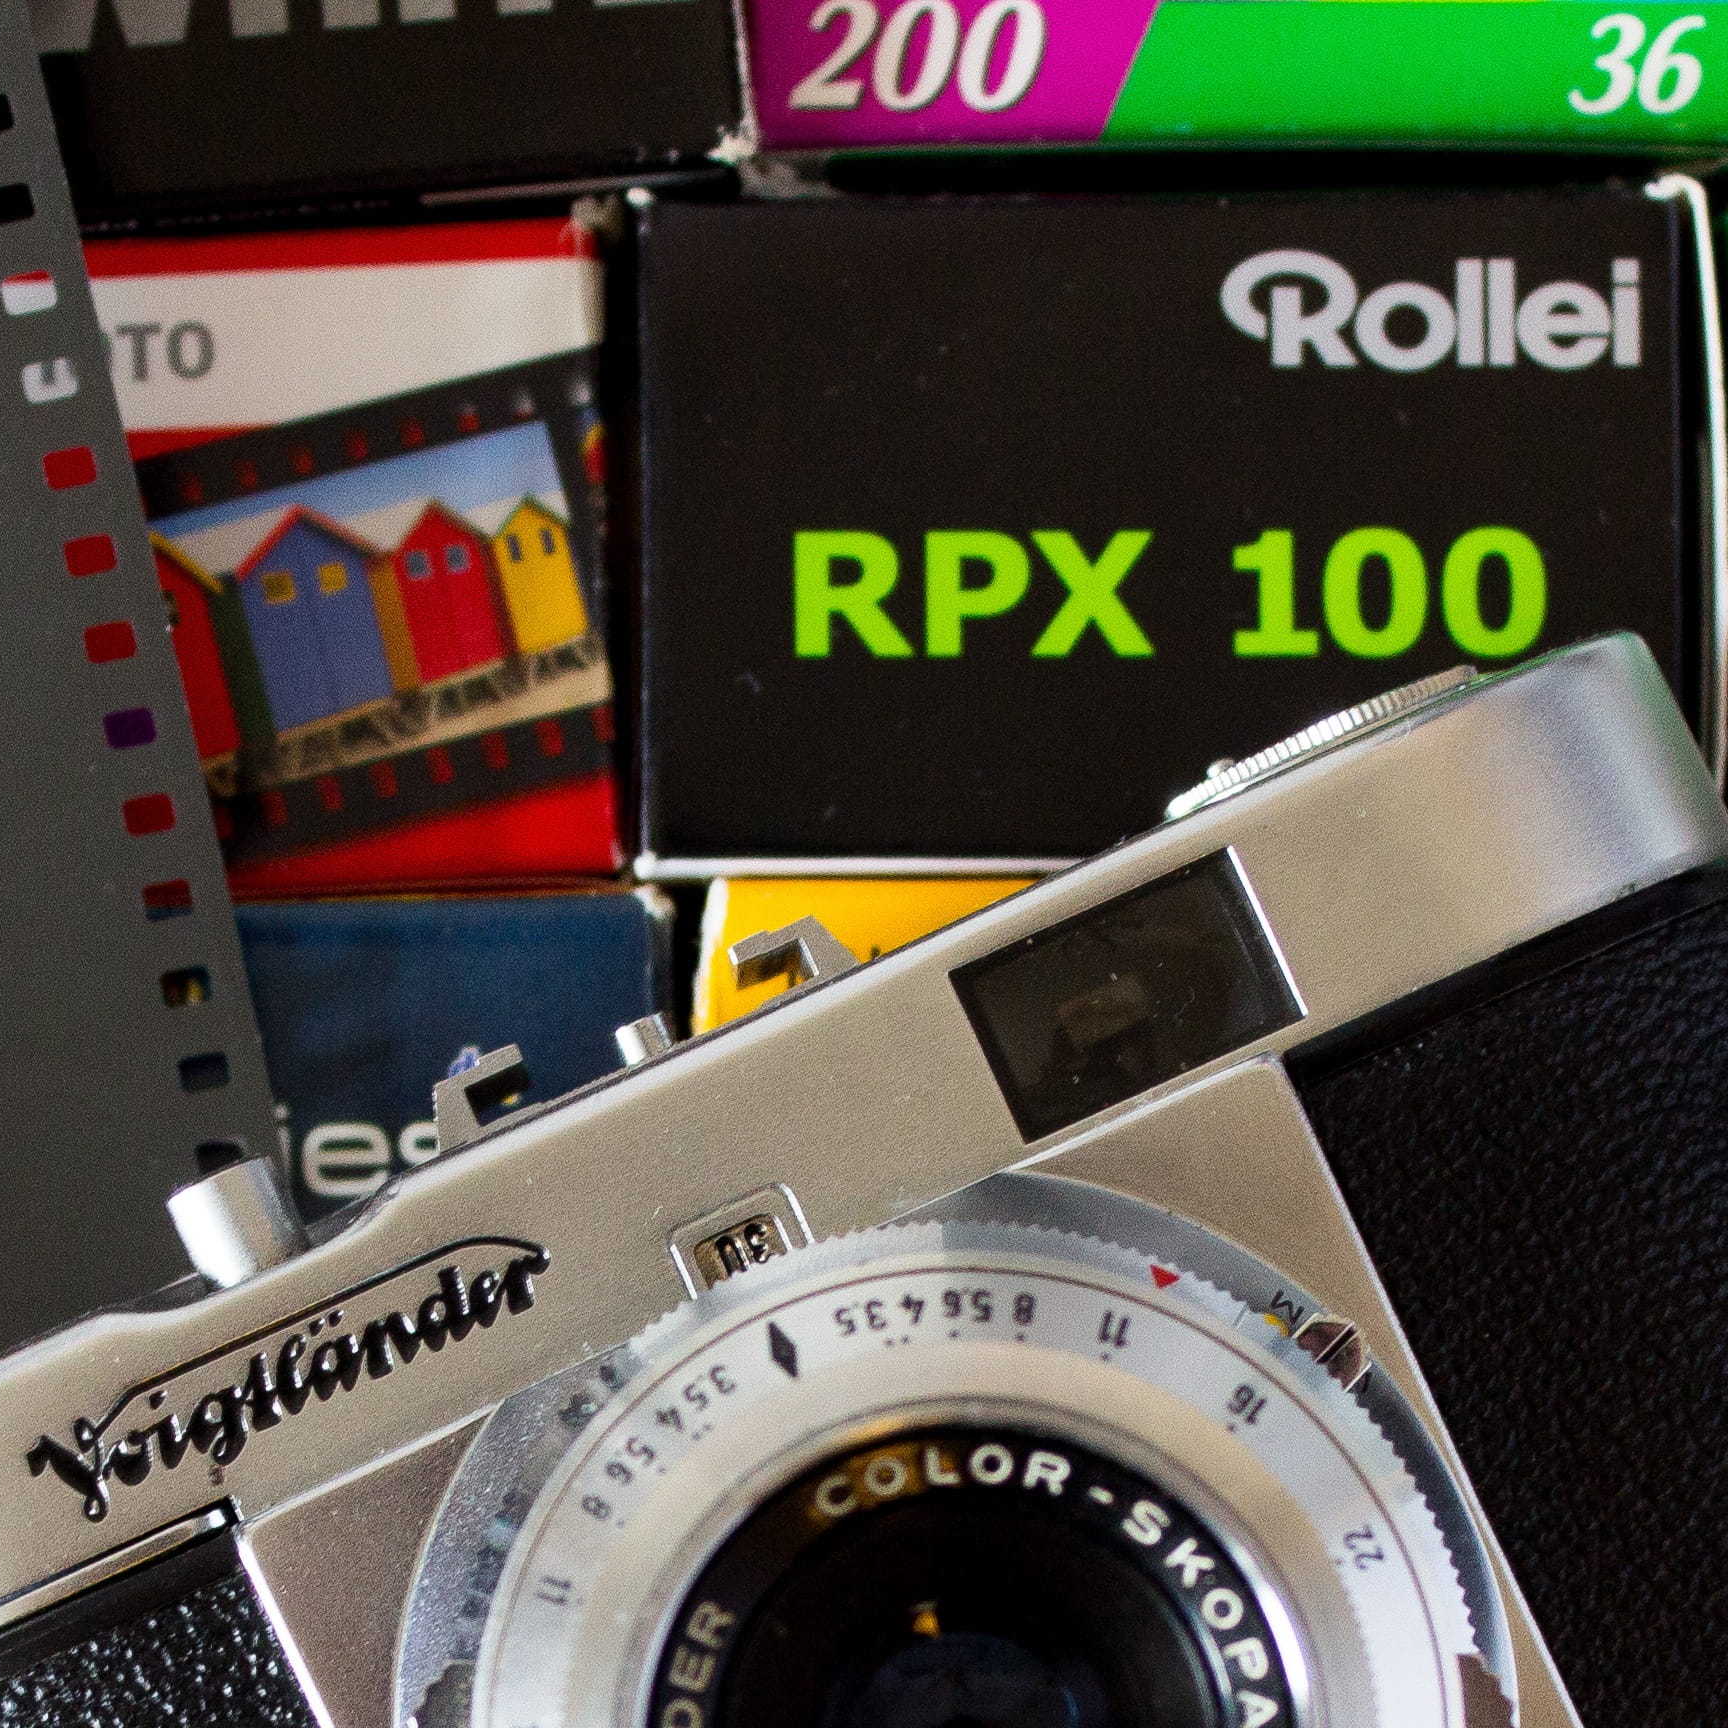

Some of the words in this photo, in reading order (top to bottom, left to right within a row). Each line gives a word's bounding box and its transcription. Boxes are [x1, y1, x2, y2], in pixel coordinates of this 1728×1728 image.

[1568, 13, 1704, 115] 36
[1219, 248, 1642, 373] Rollei
[792, 529, 1155, 660] RPX
[1232, 525, 1547, 661] 100
[27, 1236, 551, 1523] Voigtländer
